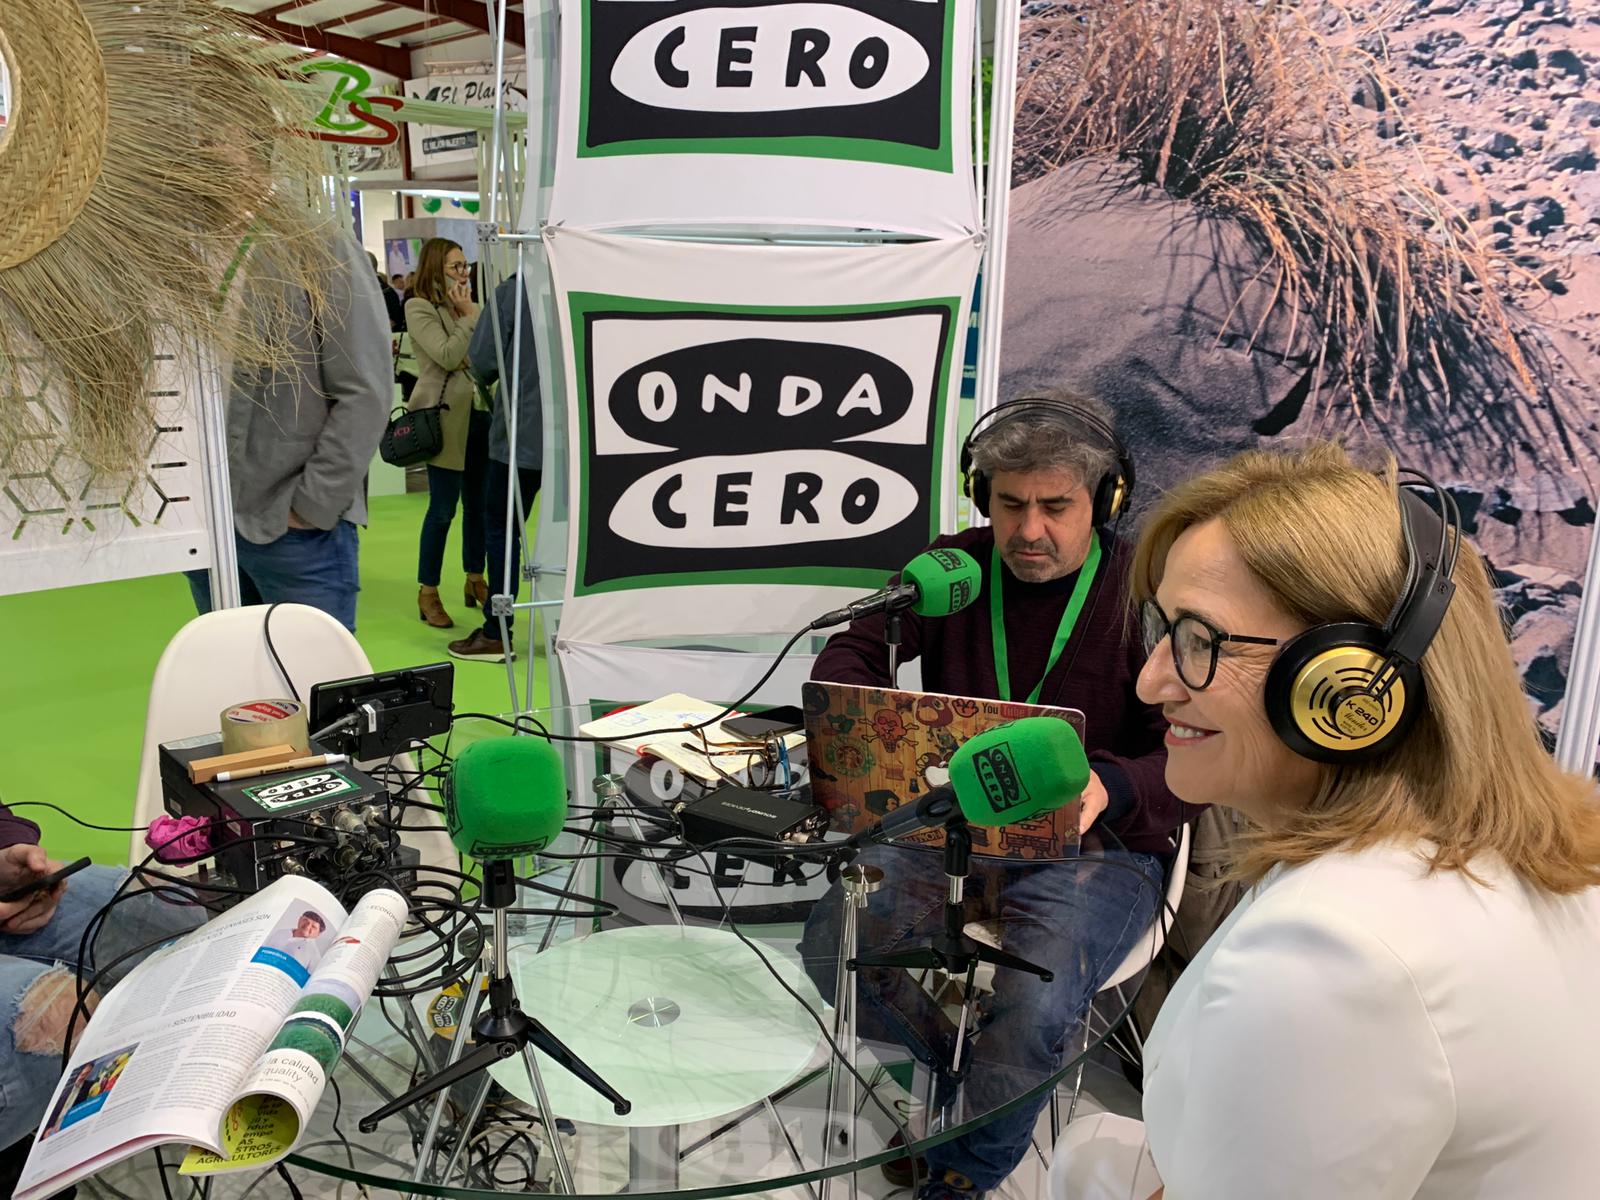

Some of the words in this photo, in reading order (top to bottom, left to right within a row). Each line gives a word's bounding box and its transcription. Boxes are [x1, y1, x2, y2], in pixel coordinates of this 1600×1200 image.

[654, 25, 889, 89] CERO
[637, 371, 882, 423] ONDA
[652, 471, 880, 529] CERO
[1345, 700, 1357, 710] K
[1355, 707, 1378, 726] 240
[980, 761, 1003, 803] CERO
[993, 752, 1017, 800] ONDA
[281, 1058, 320, 1086] calidad
